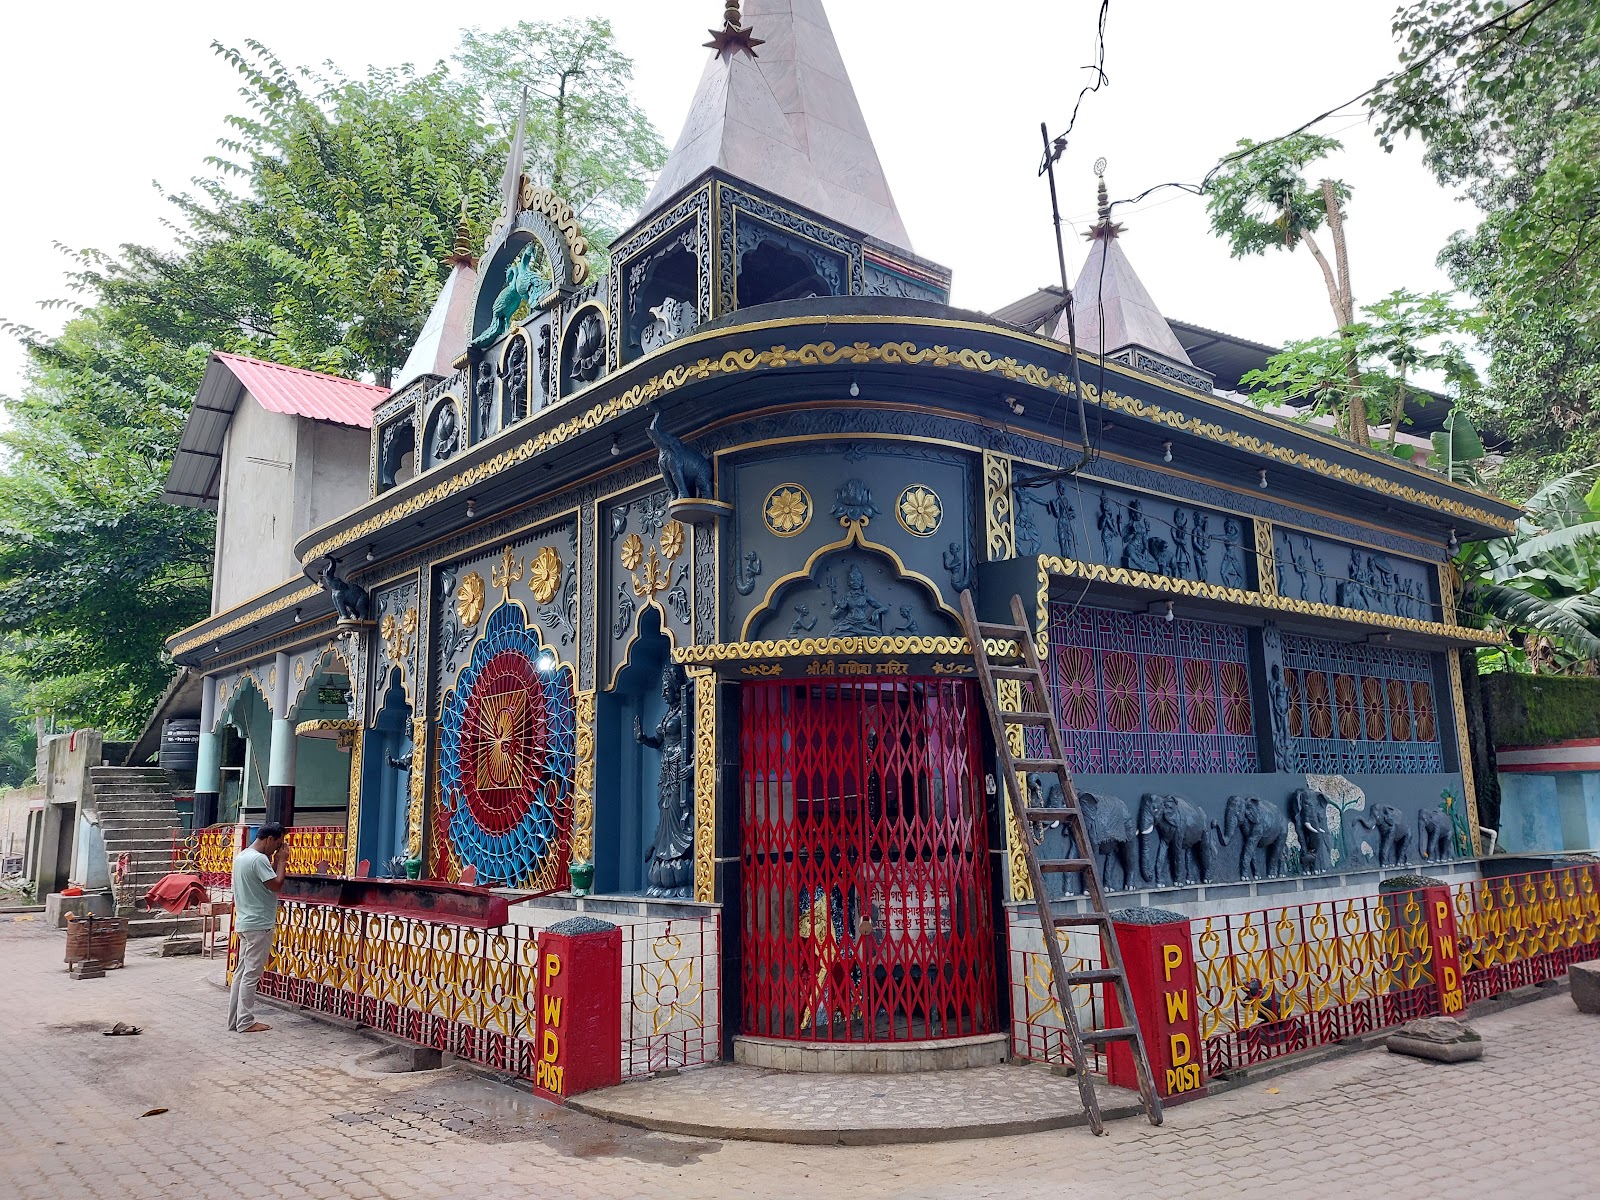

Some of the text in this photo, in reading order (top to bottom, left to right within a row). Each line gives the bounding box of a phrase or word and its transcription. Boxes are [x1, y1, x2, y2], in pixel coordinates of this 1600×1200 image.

[1436, 901, 1456, 991] PWD
[544, 953, 561, 1063] PWD
[1163, 944, 1191, 1067] PWD
[1443, 989, 1463, 1014] POST
[536, 1059, 564, 1094] POST
[1166, 1063, 1200, 1096] POST
